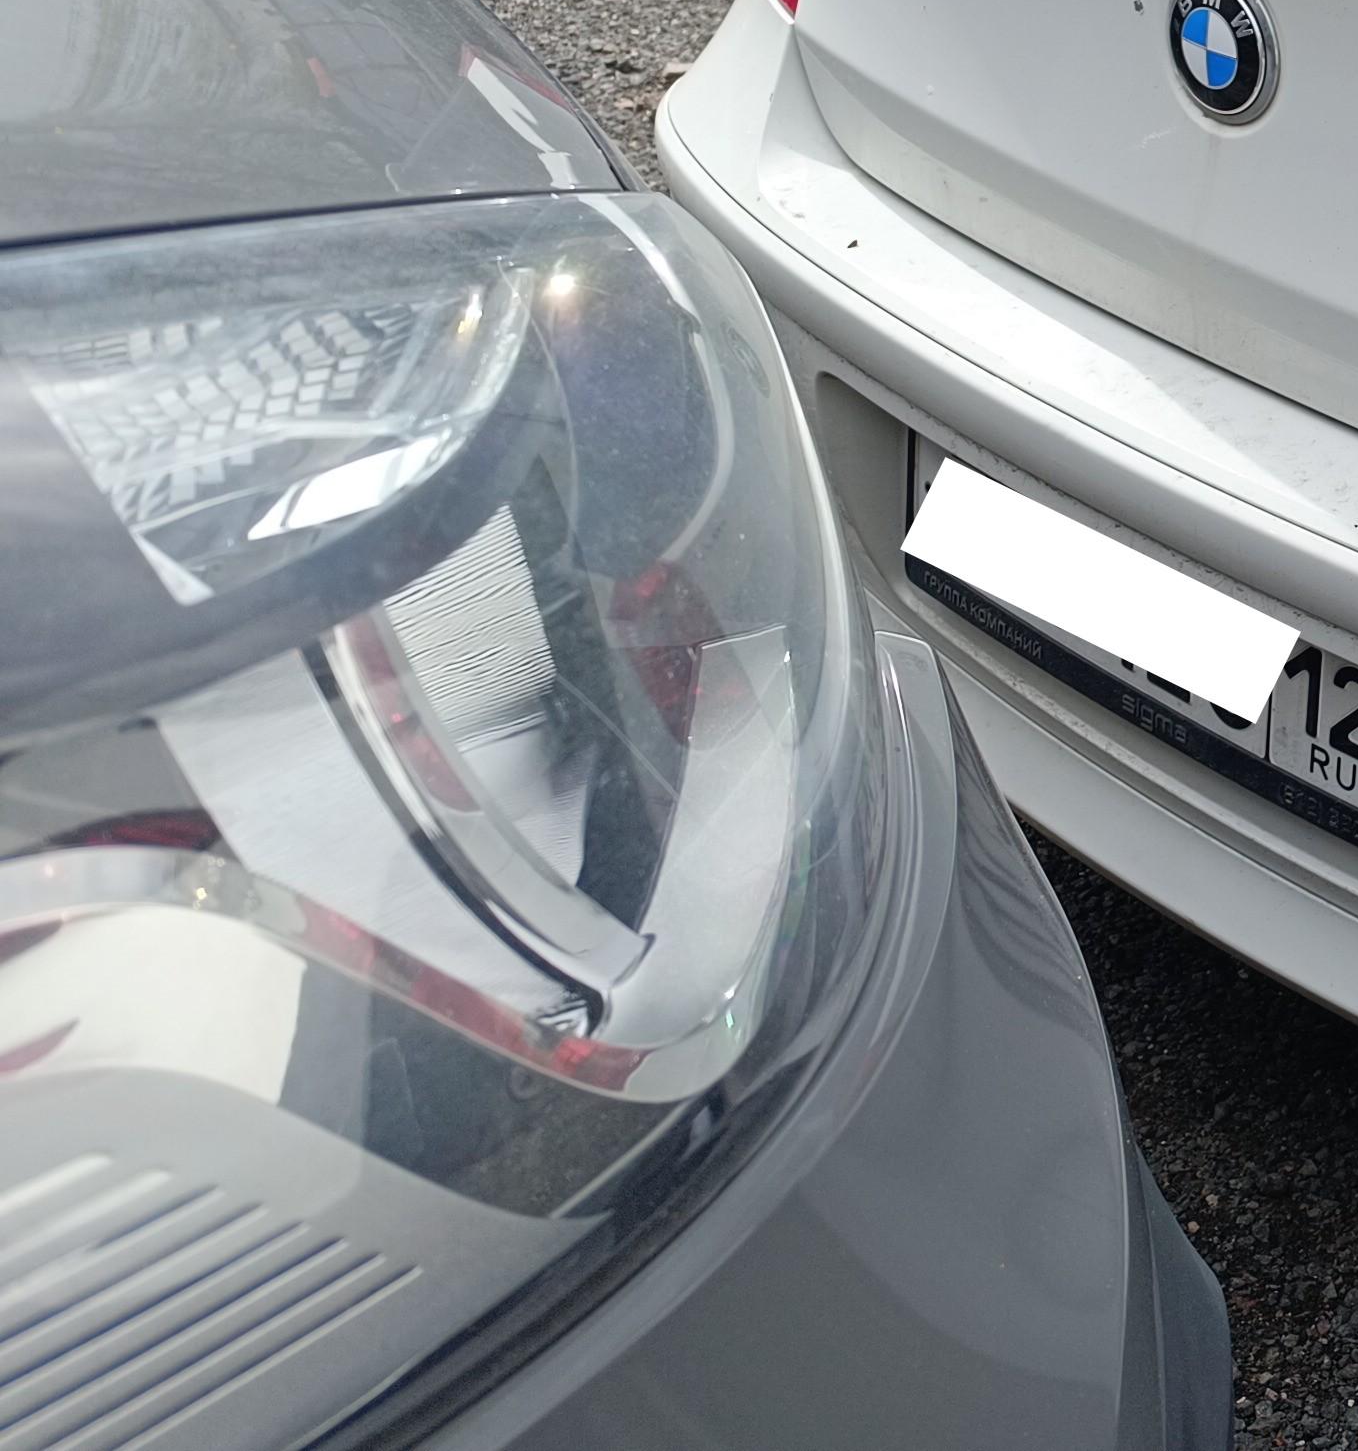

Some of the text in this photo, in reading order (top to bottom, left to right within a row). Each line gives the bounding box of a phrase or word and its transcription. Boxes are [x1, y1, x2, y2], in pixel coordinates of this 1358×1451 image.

[924, 570, 1044, 658] ГРУППА КОМПАНИЙ
[1121, 693, 1188, 744] sigma
